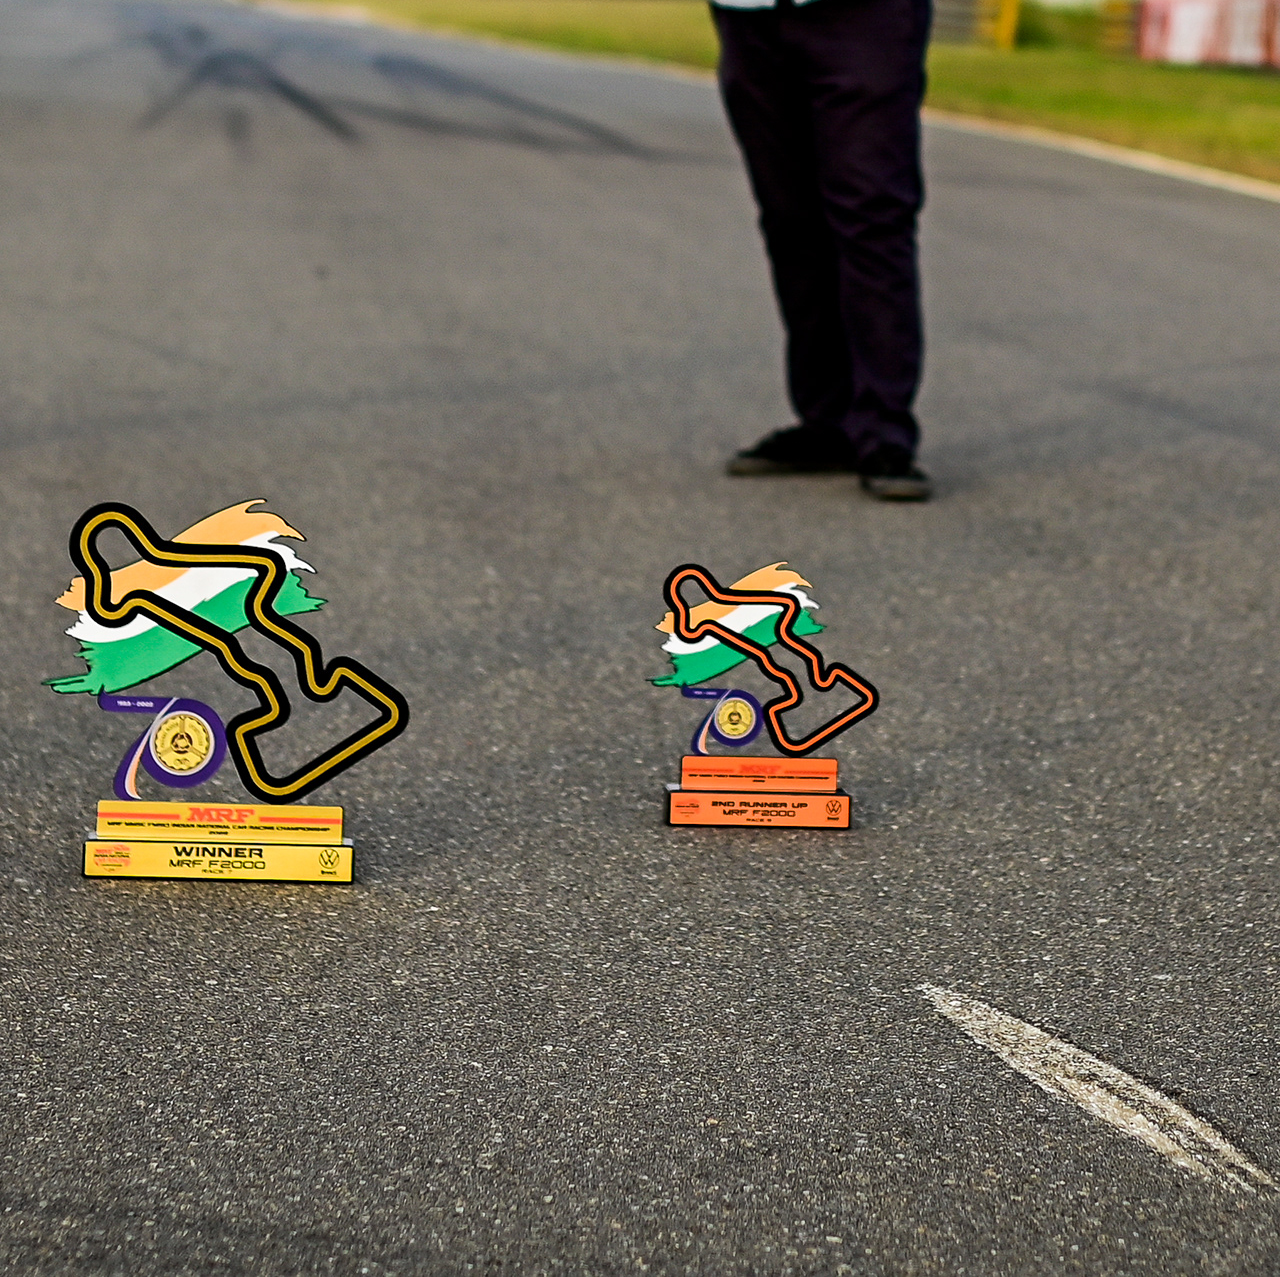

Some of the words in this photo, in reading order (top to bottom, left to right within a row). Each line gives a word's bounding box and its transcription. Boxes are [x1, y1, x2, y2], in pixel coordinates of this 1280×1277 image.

[711, 800, 735, 808] 2ND
[739, 801, 787, 809] RUNNER
[187, 807, 255, 823] MRF
[722, 808, 748, 816] MRF
[752, 809, 796, 818] F2000
[174, 846, 263, 858] WINNER
[168, 859, 203, 868] MRF
[208, 860, 265, 869] F2000
